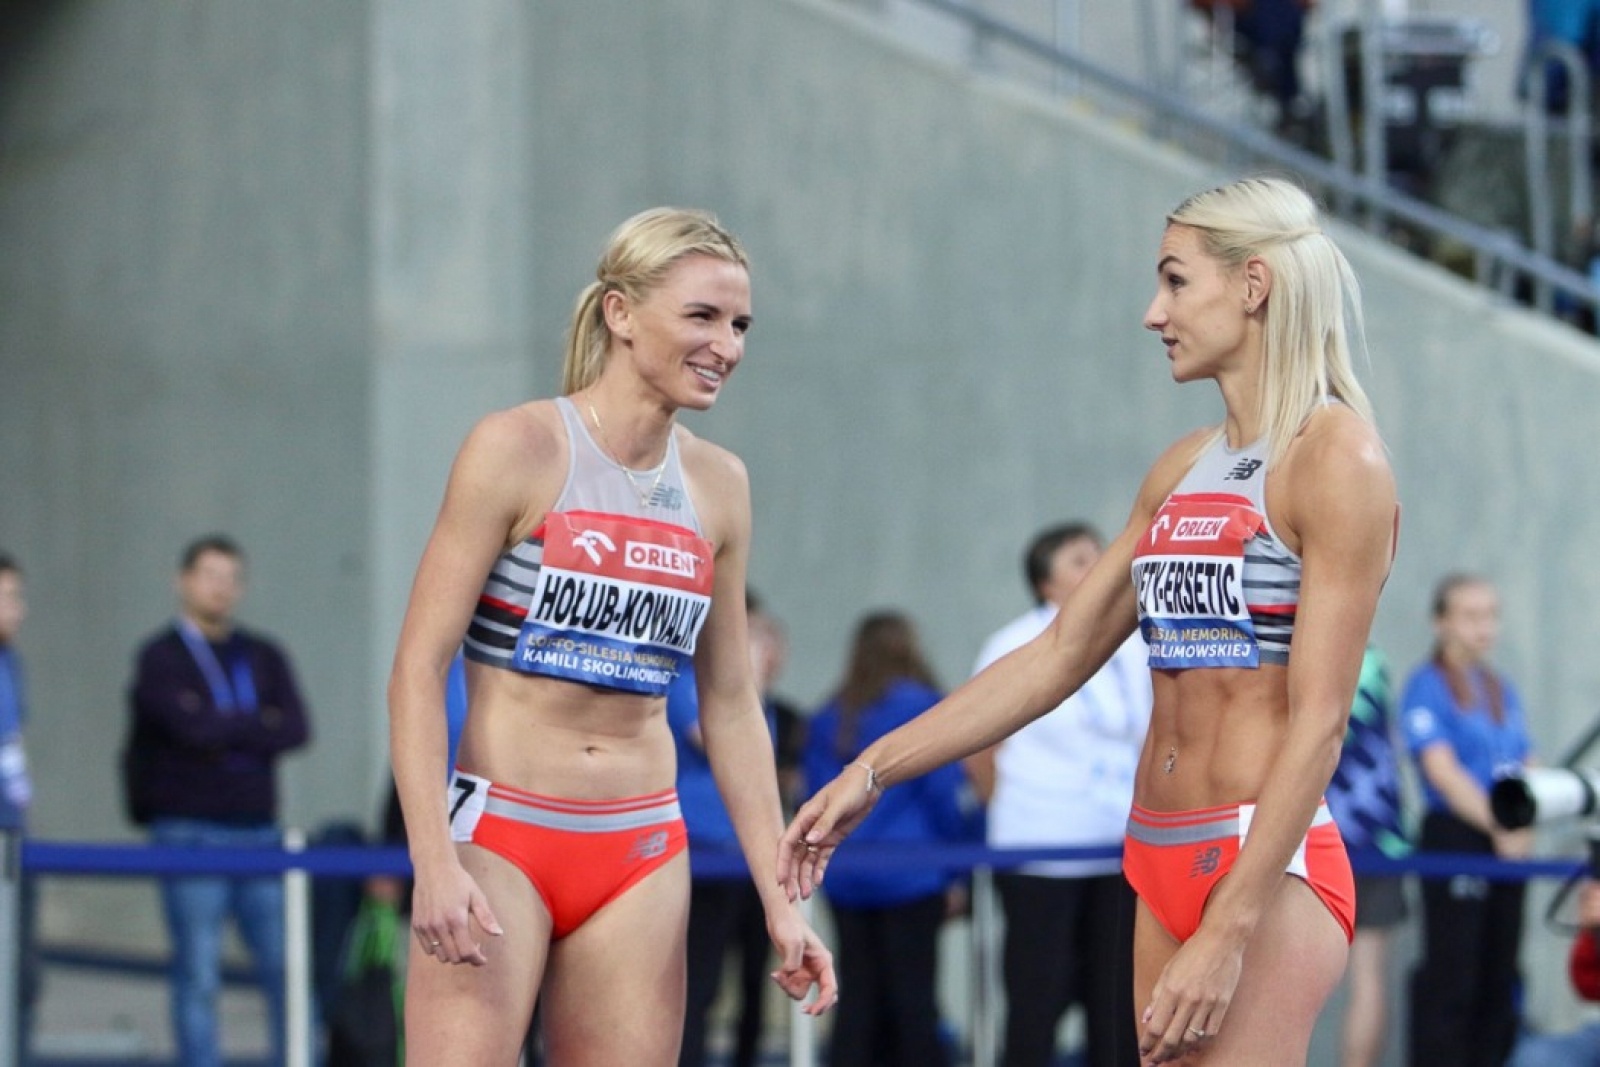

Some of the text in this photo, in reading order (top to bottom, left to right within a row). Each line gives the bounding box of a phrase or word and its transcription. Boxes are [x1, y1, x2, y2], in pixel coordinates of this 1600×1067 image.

[1175, 519, 1223, 537] ORLEN
[630, 546, 693, 574] ORLEN
[535, 573, 705, 650] HOŁUB-KOWALIK
[523, 647, 579, 670] KAMILI
